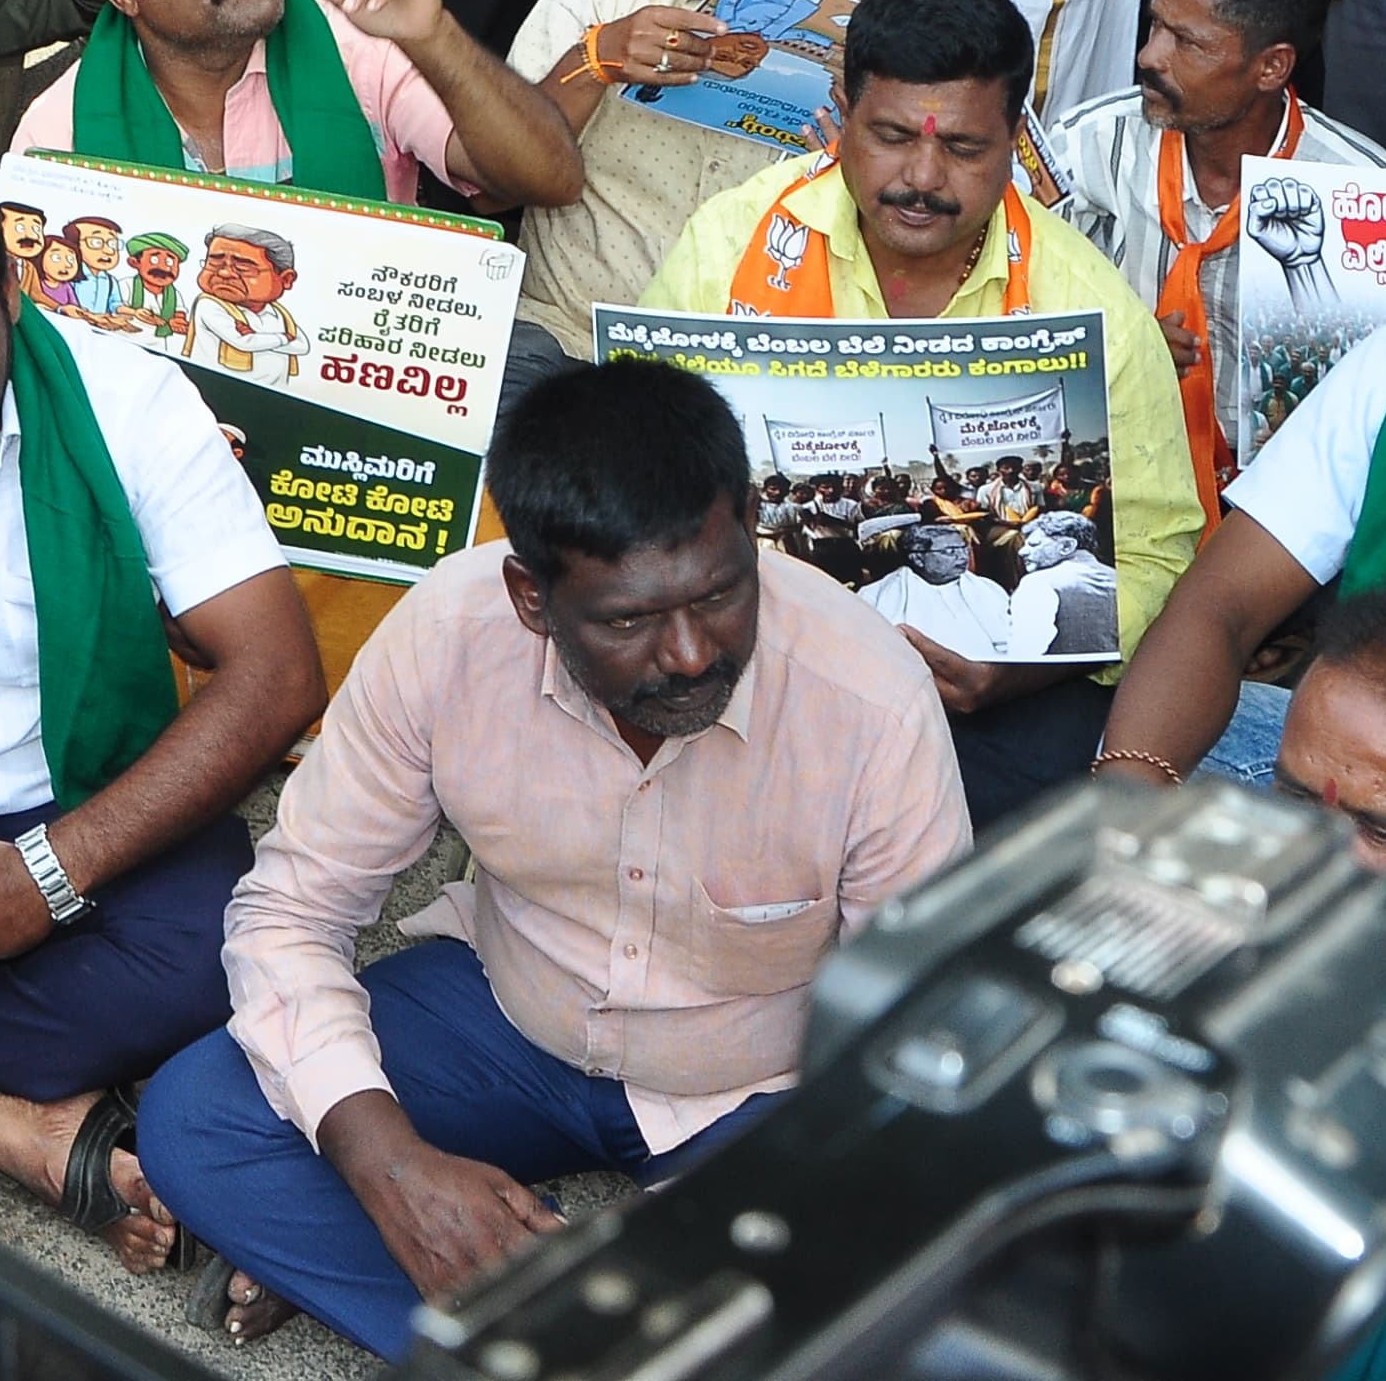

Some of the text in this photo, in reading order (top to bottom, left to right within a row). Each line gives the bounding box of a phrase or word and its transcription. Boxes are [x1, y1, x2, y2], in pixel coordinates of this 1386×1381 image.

[371, 265, 458, 294] ನೌಕರರಿಗೆ
[337, 281, 482, 321] ಸಂಬಳ ನೀಡಲು,
[373, 309, 441, 336] ರೈತರಿಗೆ
[608, 322, 744, 358] ಮೆಕ್ಕೆಜೋಳಕ್ಕೆ
[746, 333, 831, 354] ಬೆಂಬಲ
[837, 335, 886, 355] ಬೆಲೆ
[892, 334, 975, 354] ನೀಡದ
[980, 326, 1087, 354] ಕಾಂಗ್ರೆಸ್
[318, 326, 486, 369] ಪರಿಹಾರ ನೀಡಲು
[768, 352, 1087, 379] ಸಿಗದೆ ಬೆಳೆಗಾರರು ಕಂಗಾಲು!!
[320, 353, 468, 417] ಹಣವಿಲ್ಲ
[299, 444, 436, 485] ಮುಸ್ಲಿಮರಿಗೆ
[269, 469, 454, 523] ಕೋಟಿ ಕೋಟಿ
[266, 502, 429, 551] ಅನುದಾನ
